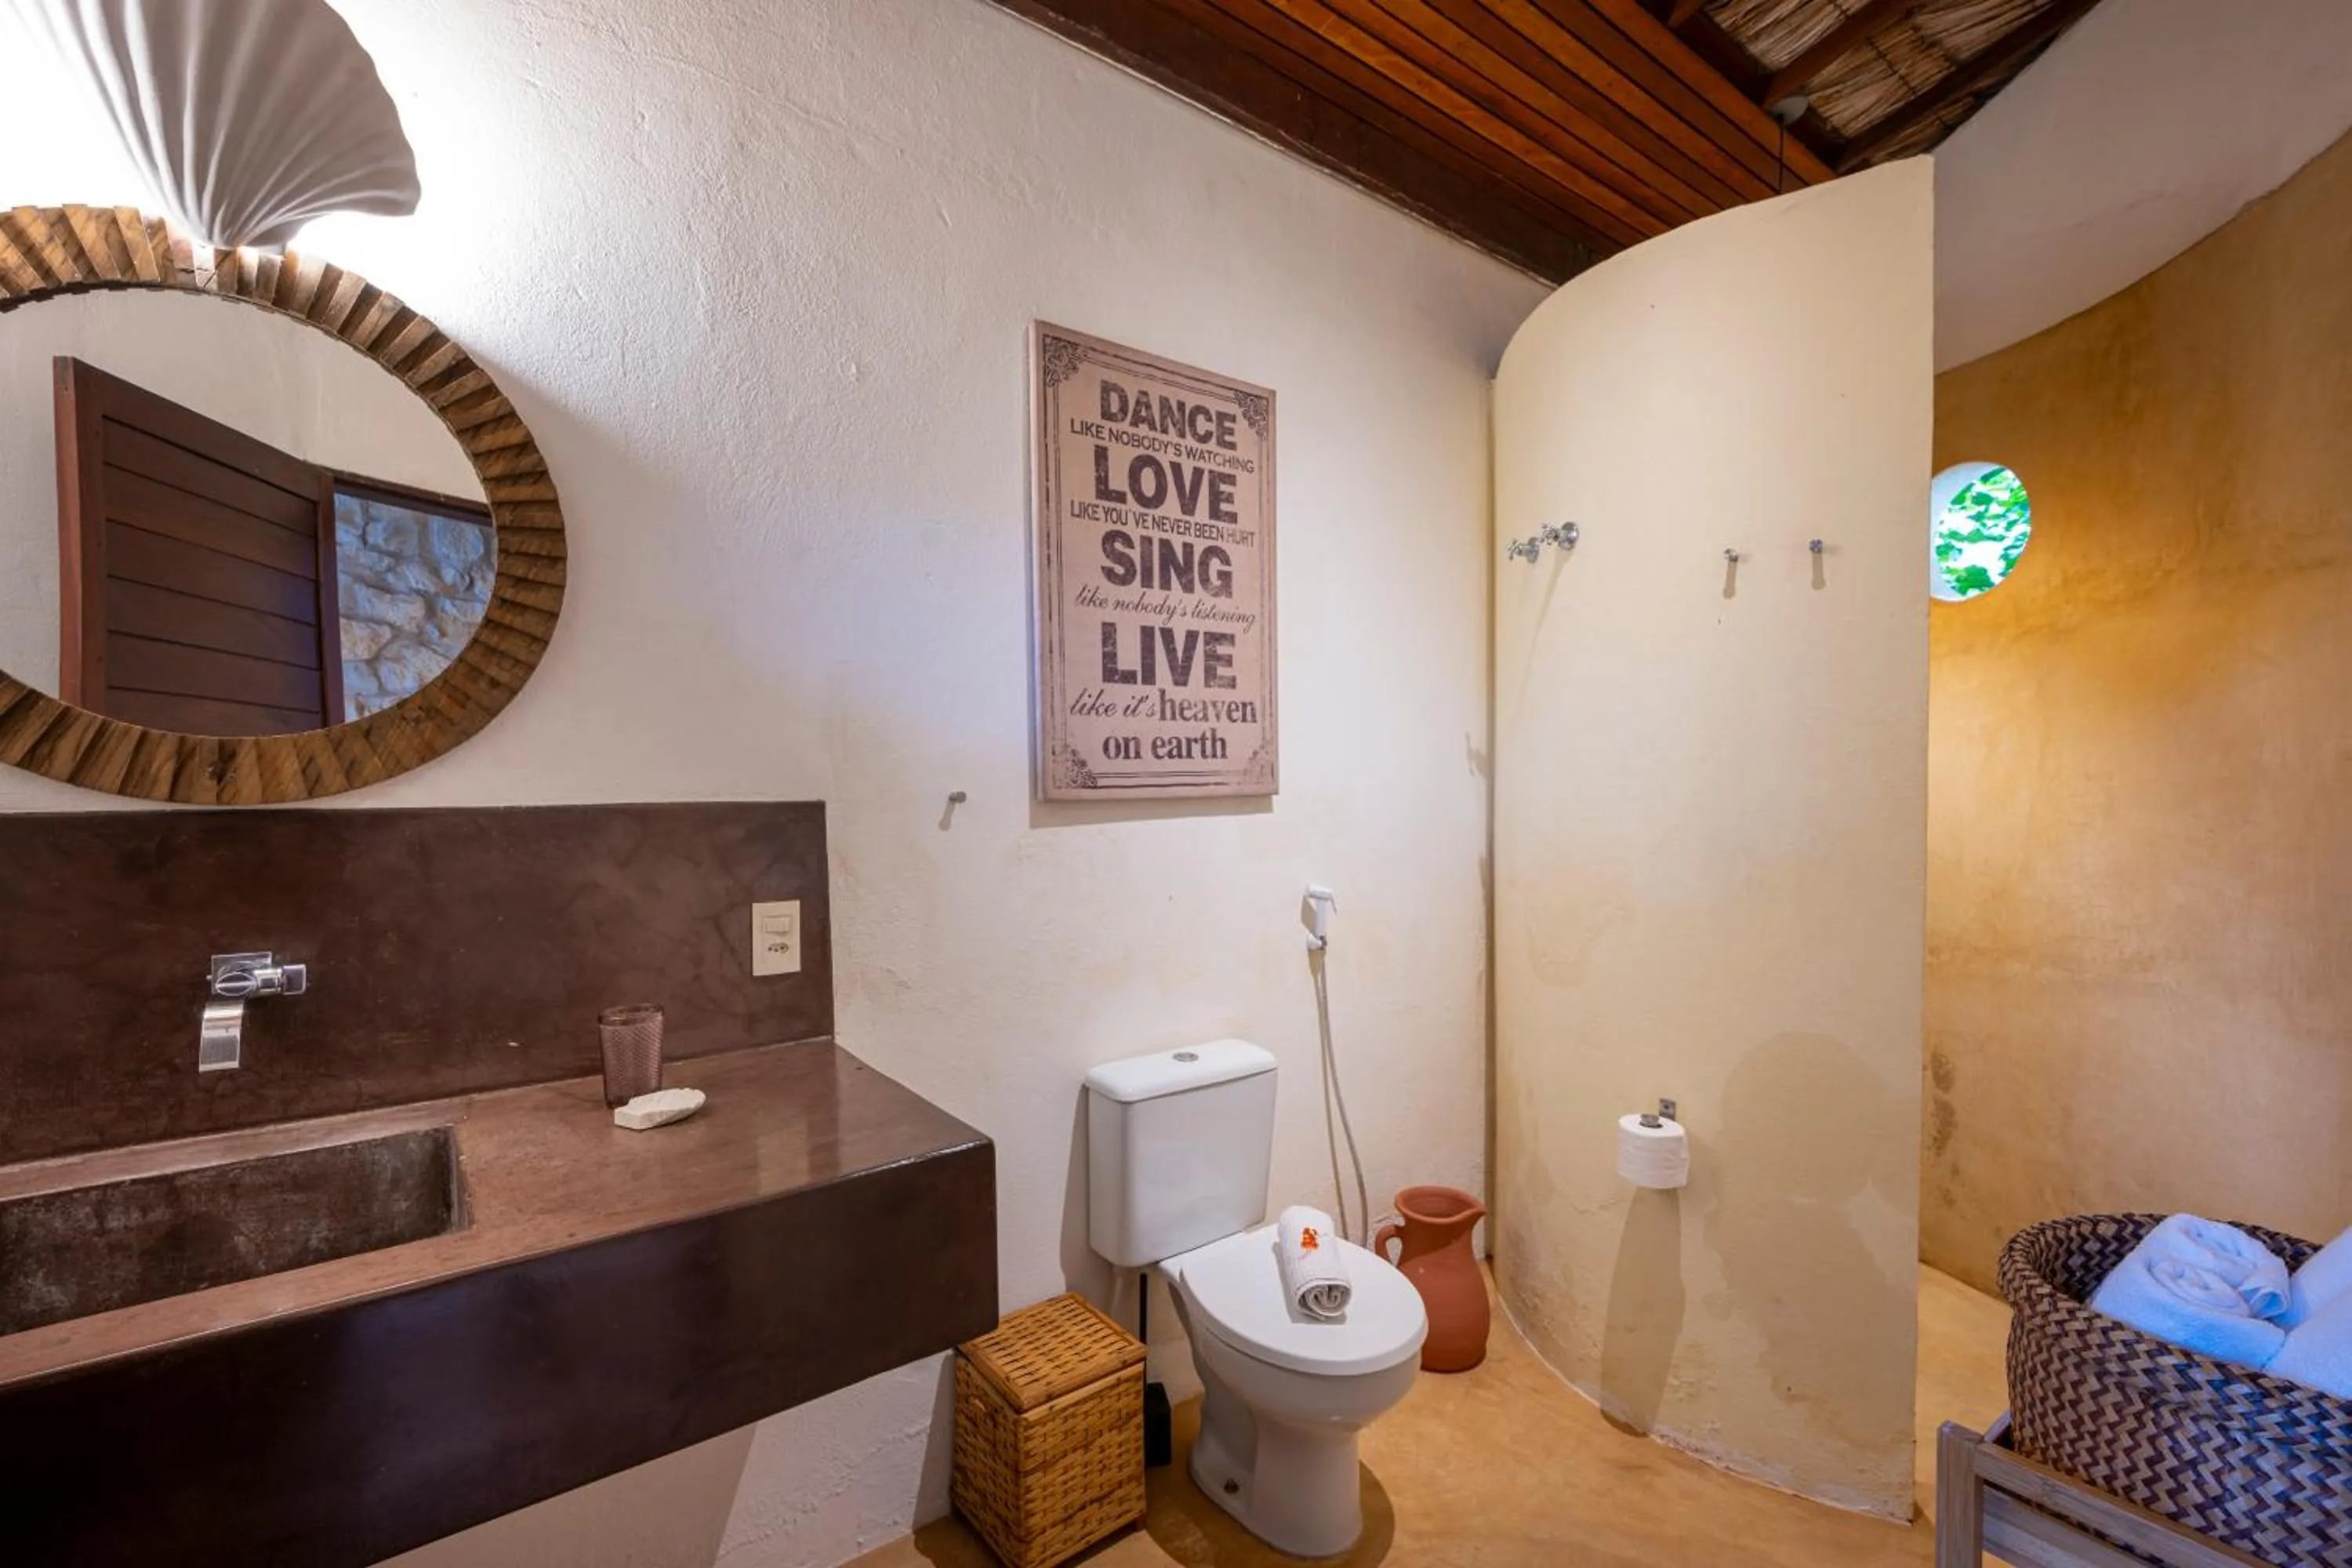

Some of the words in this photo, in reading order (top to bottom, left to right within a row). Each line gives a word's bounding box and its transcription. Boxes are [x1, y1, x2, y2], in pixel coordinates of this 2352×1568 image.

[1100, 379, 1237, 451] DANCE
[1070, 418, 1105, 440] LIKE
[1109, 426, 1182, 458] NOBODY'S
[1185, 445, 1255, 474] WATCHING
[1094, 444, 1238, 524] LOVE
[1070, 499, 1100, 521] LIKE
[1152, 515, 1192, 535] NEVER
[1194, 521, 1224, 541] BEEN
[1226, 527, 1255, 548] HURT
[1100, 529, 1233, 599] SING
[1074, 583, 1109, 609] like
[1112, 591, 1187, 626] nobody's
[1191, 601, 1256, 633] listening
[1101, 622, 1237, 690] LIVE
[1069, 688, 1118, 717] like
[1122, 695, 1156, 718] it's
[1157, 688, 1258, 724] heaven
[1102, 735, 1143, 760] on
[1150, 728, 1228, 760] earth
